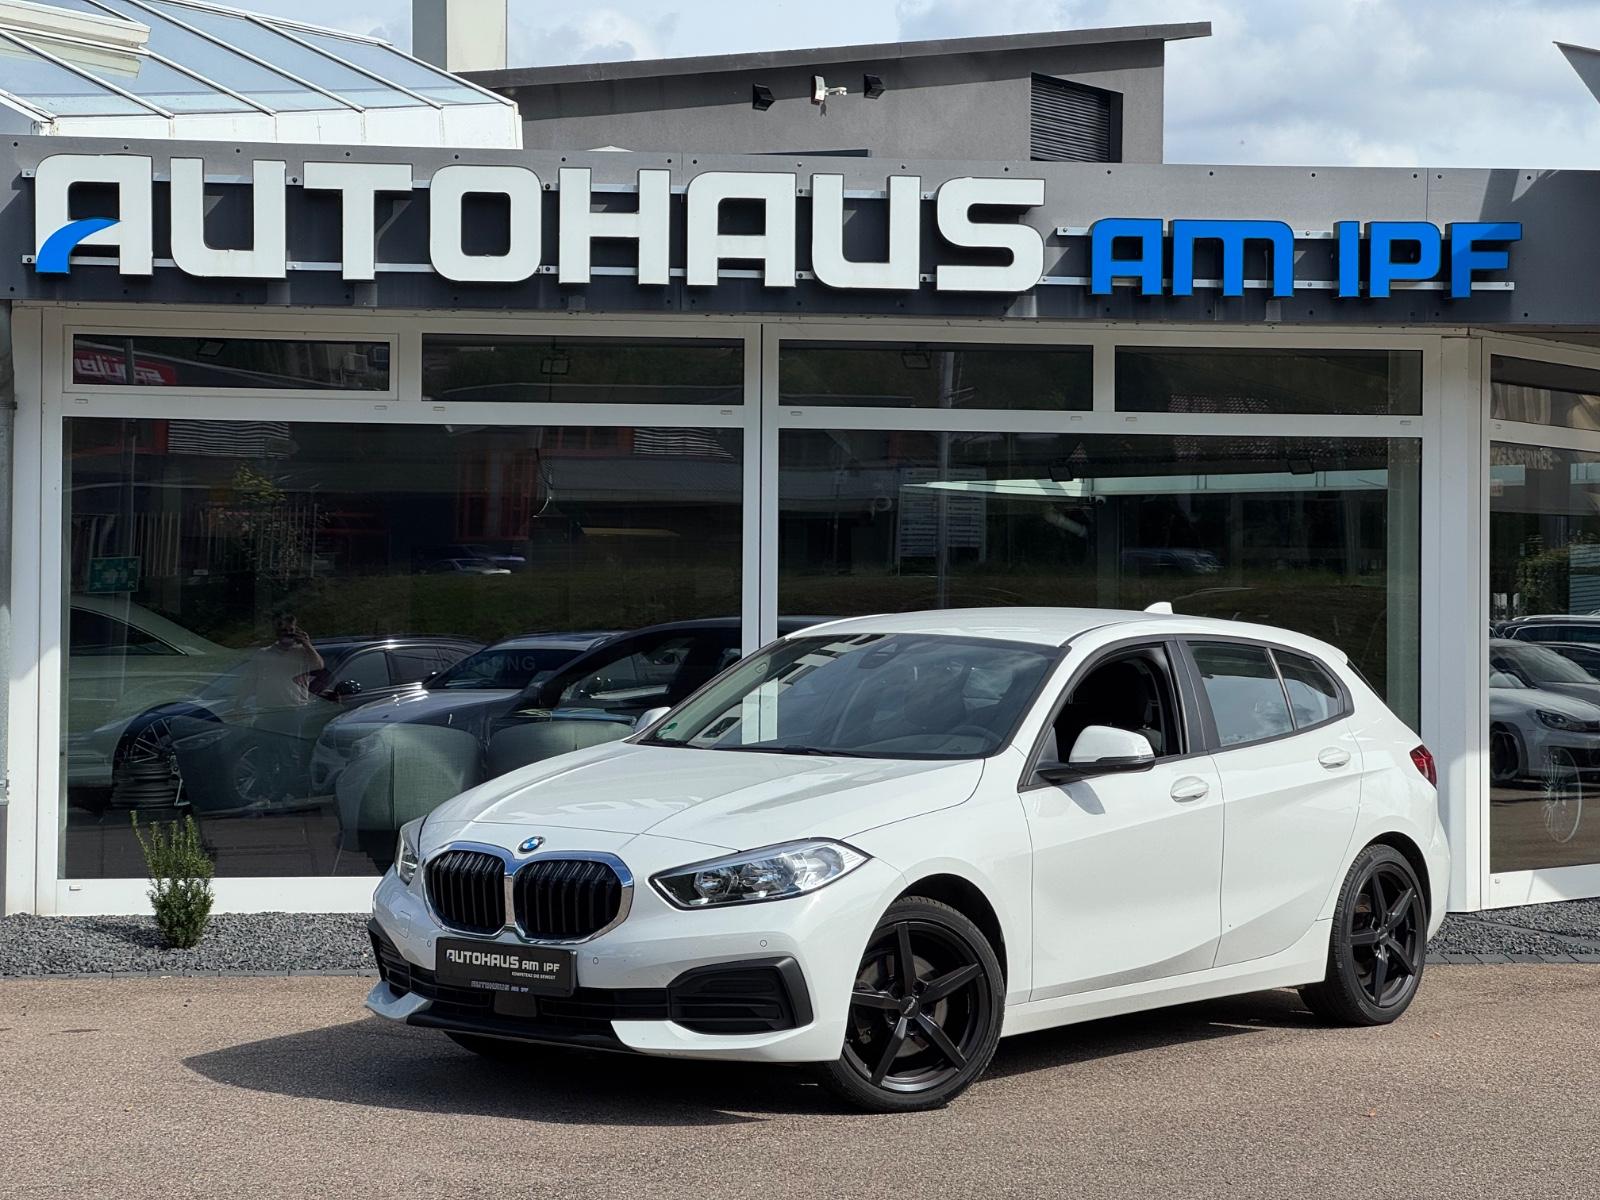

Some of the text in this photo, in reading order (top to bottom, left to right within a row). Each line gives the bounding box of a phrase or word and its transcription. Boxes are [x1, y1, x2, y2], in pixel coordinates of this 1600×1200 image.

[34, 154, 1523, 299] AUTOHAUS AM IPF
[446, 949, 561, 974] AUTOHAUS AM IPF
